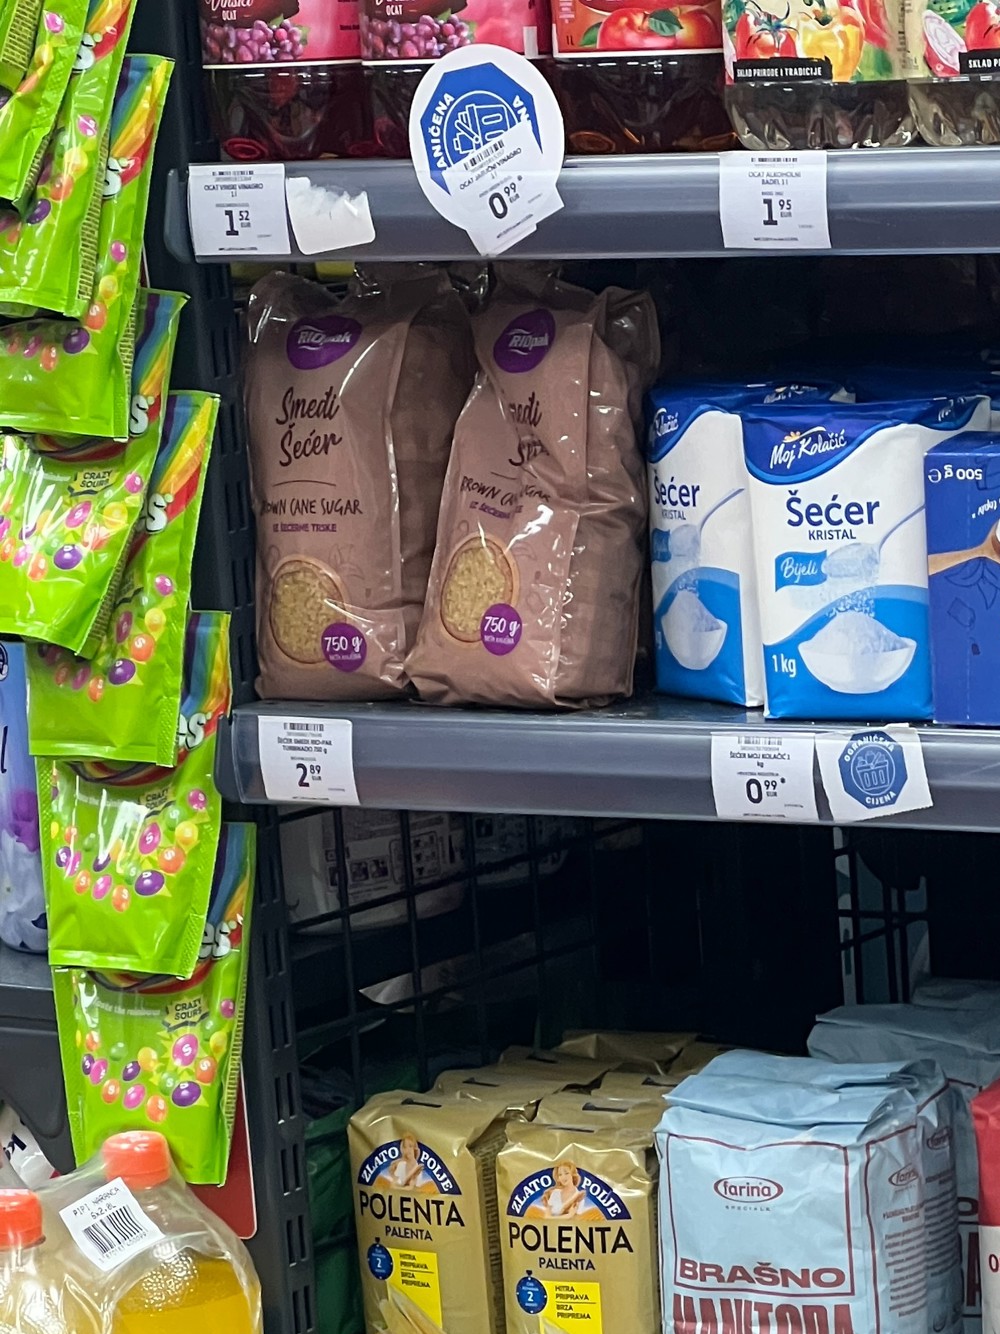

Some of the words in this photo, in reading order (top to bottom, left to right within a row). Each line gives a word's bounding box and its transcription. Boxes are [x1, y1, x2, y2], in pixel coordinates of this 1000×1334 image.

[969, 59, 992, 68] SKLAD
[488, 192, 508, 219] 0
[504, 182, 517, 197] 99
[763, 199, 778, 225] 1
[779, 199, 792, 210] 95
[224, 210, 239, 236] 1
[239, 210, 249, 221] 52
[276, 385, 340, 425] Smeđi
[279, 423, 342, 468] Šećer
[770, 445, 796, 469] Moj
[798, 428, 847, 454] Kolačić
[289, 498, 316, 515] CANE
[321, 497, 363, 516] SUGAR
[786, 491, 880, 527] Šećer
[808, 528, 857, 541] KRISTAL
[781, 557, 818, 579] Bijeli
[484, 617, 508, 632] 750
[509, 616, 522, 636] g
[324, 636, 349, 652] 750
[350, 635, 363, 656] g
[296, 763, 310, 787] 2
[310, 764, 321, 774] 89
[746, 778, 763, 804] 0
[764, 780, 777, 790] 99
[864, 790, 897, 806] CIJENA
[174, 998, 201, 1011] CRAZY
[174, 1008, 202, 1021] SOURS
[361, 1147, 399, 1183] ZLATO
[419, 1152, 454, 1192] POLJE
[512, 1175, 552, 1214] ZLATO
[581, 1177, 621, 1218] POLJE
[723, 1182, 773, 1199] farina
[359, 1190, 465, 1227] POLENTA
[385, 1225, 433, 1242] PALENTA
[508, 1222, 634, 1254] POLENTA
[539, 1257, 596, 1271] PALENTA
[679, 1259, 846, 1289] BRAŠNO
